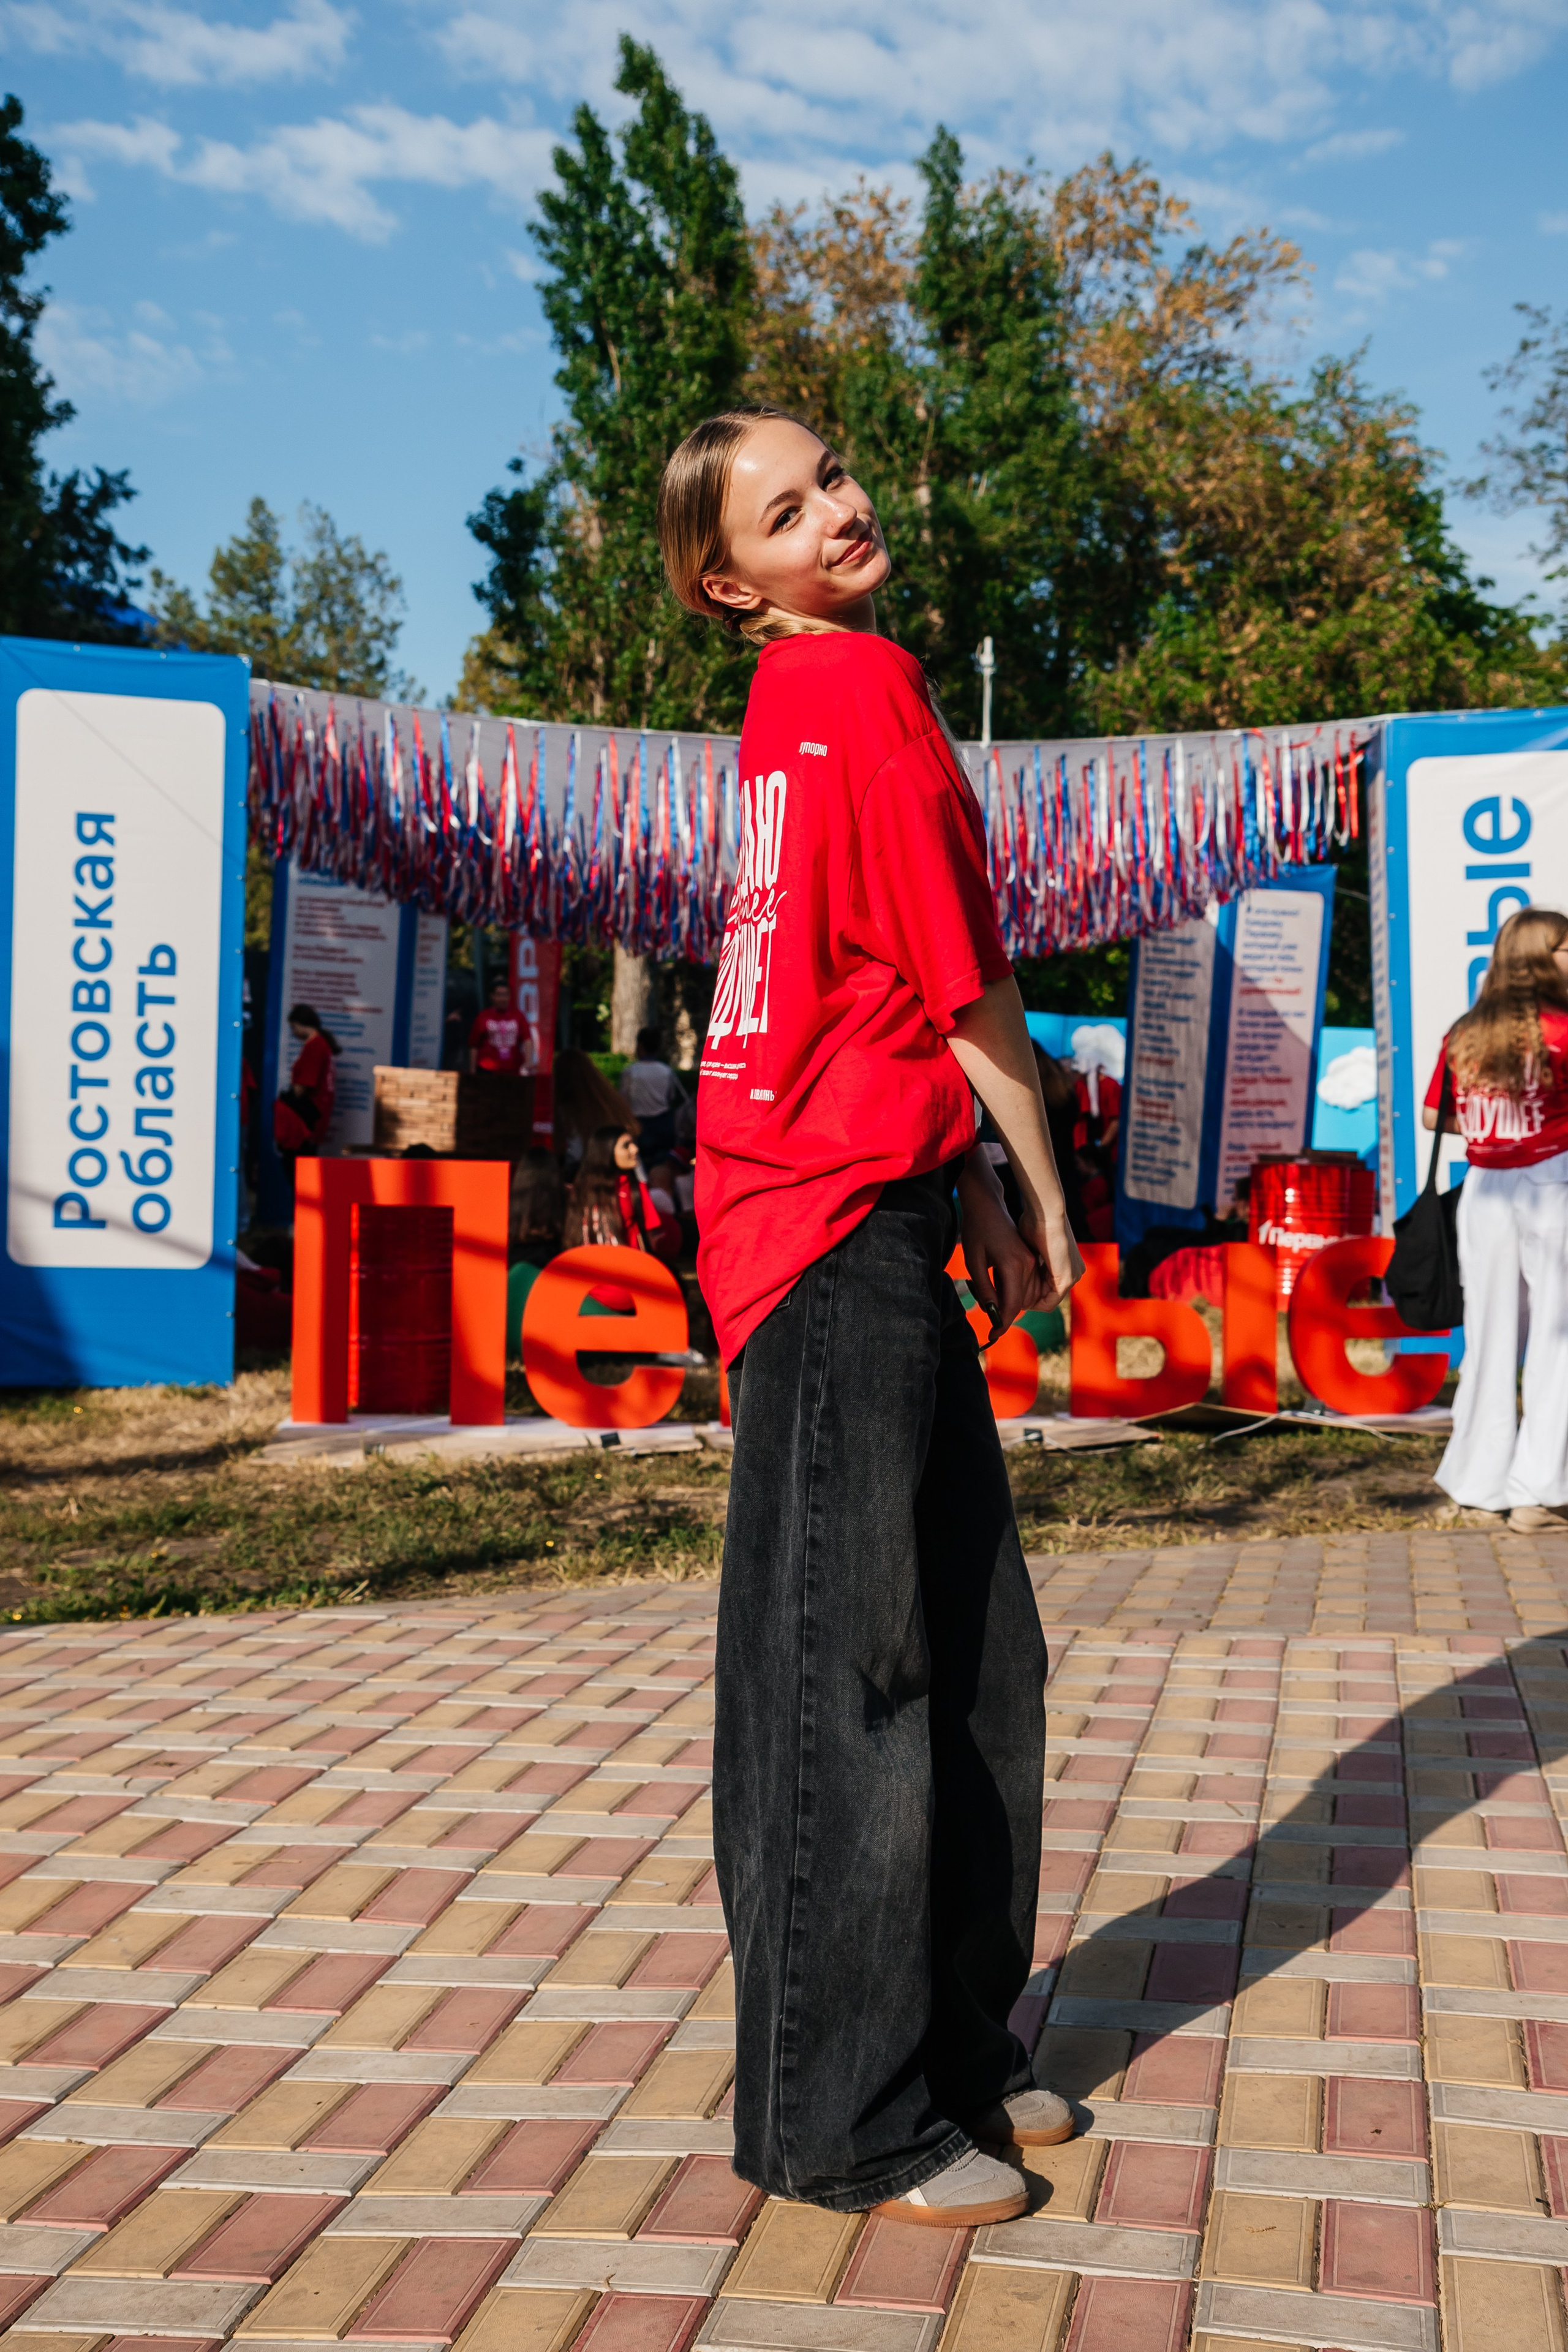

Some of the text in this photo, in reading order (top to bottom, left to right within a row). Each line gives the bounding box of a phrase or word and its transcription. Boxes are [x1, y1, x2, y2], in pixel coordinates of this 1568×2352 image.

[53, 812, 116, 1229] Ростовская
[120, 943, 177, 1234] область
[291, 1156, 1450, 1429] Пеые
